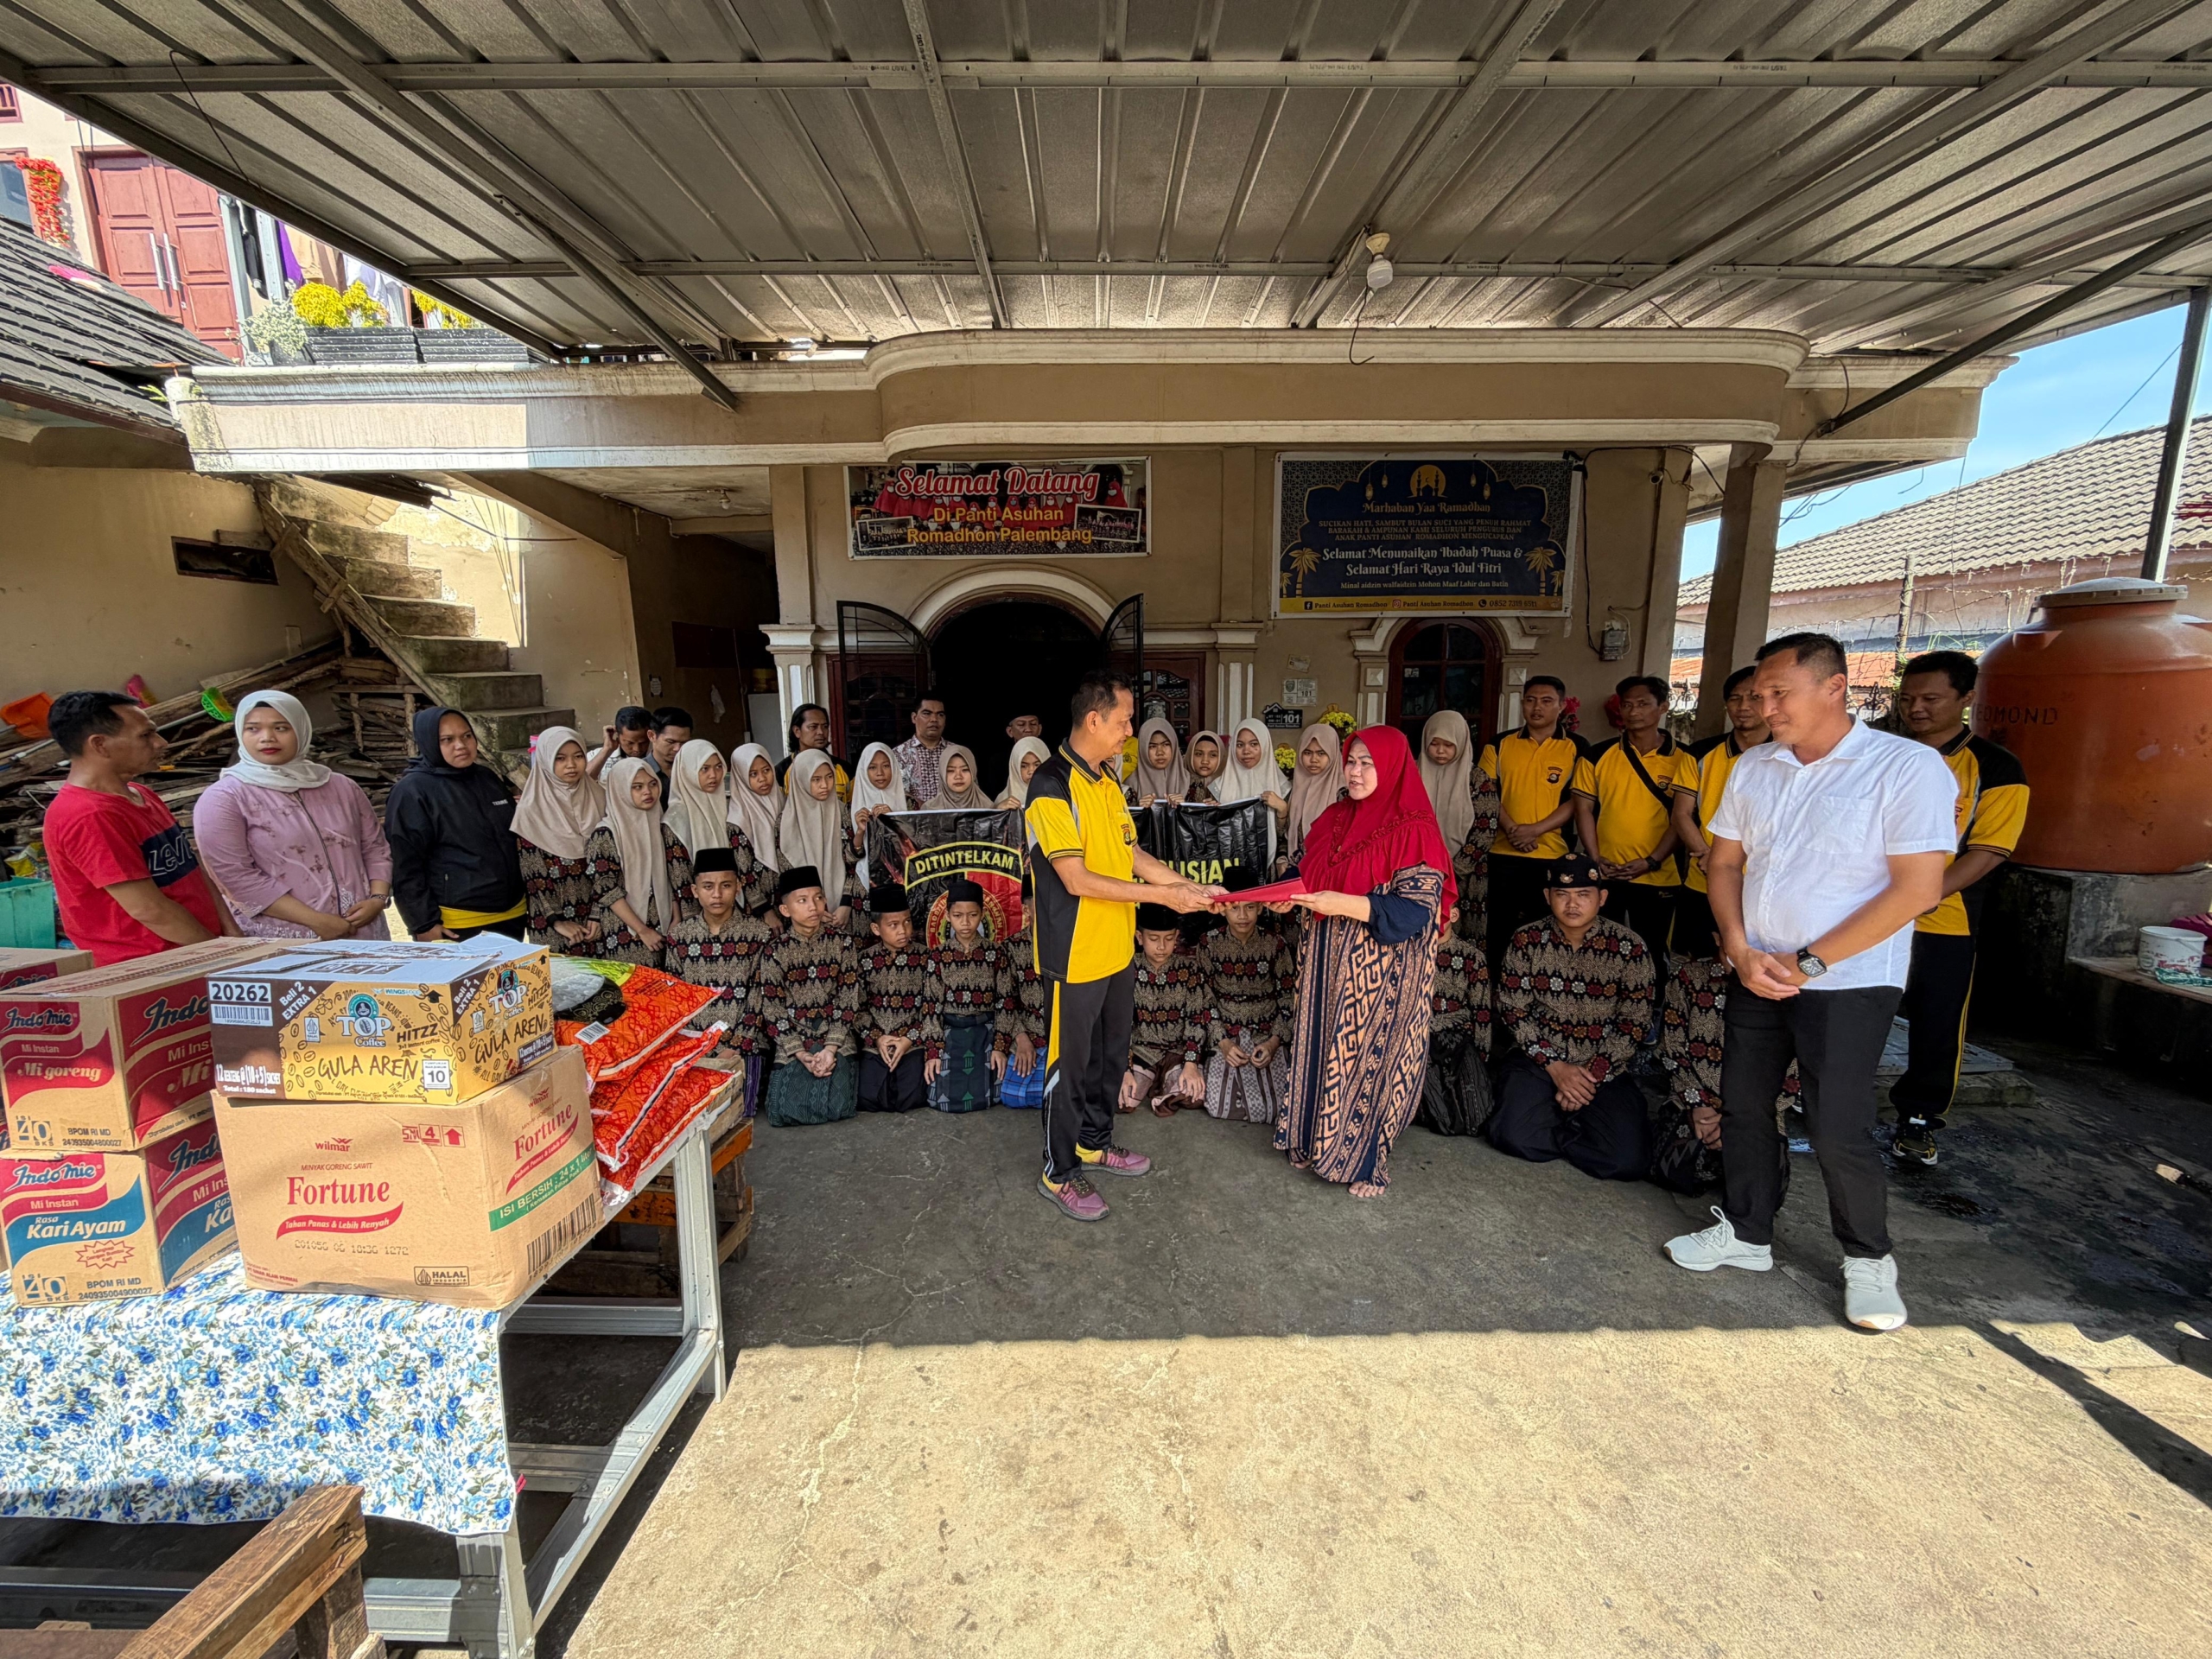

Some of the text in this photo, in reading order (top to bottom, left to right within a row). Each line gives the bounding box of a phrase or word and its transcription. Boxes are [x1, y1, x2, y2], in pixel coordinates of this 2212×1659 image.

[895, 466, 1101, 500] Selamat Datang
[934, 505, 1064, 523] Di Panti Asuhan
[1362, 500, 1491, 516] Marhaban Yaa Ramadhan
[907, 527, 1093, 544] Romadhon Palembang
[1322, 545, 1523, 561] Selamat Menunaikan Ibadah Puasa &
[1345, 561, 1502, 576] Selamat Hari Raya Idul Fitri
[1283, 714, 1300, 723] 101
[915, 850, 1014, 875] DITINTELKAM
[211, 982, 270, 1002] 20262
[279, 982, 305, 1007] Beli 2
[454, 978, 472, 1004] Beli 2
[488, 985, 528, 1015] TOP
[282, 986, 317, 1021] EXTRA 1
[455, 988, 477, 1015] EXTRA
[132, 996, 209, 1045] Indo
[503, 1005, 525, 1020] Coffee
[336, 1015, 393, 1038] TOP
[397, 1023, 438, 1043] HITZZ
[22, 1044, 60, 1053] Mi Instan
[353, 1035, 387, 1048] Coffee
[475, 1013, 544, 1065] GULA AREN
[168, 1039, 212, 1062] Mi Ins
[44, 1065, 102, 1082] goreng
[167, 1058, 213, 1093] Mi
[318, 1054, 419, 1080] GULA AREN
[428, 1070, 446, 1084] 10
[528, 1092, 550, 1109] wilmar
[17, 1120, 54, 1141] 40
[67, 1128, 90, 1136] BPOM
[425, 1126, 435, 1139] 4
[512, 1103, 572, 1162] Fortune
[315, 1141, 351, 1153] wilmar
[193, 1176, 229, 1202] Mi Ins
[286, 1176, 391, 1205] Fortune
[499, 1204, 515, 1219] ISI
[517, 1178, 554, 1210] BERSIH
[559, 1166, 569, 1180] 24
[30, 1198, 79, 1209] Mi Instan
[213, 1196, 232, 1211] Ras
[26, 1217, 126, 1239] Kari Ayam
[35, 1215, 59, 1224] Rasa
[205, 1205, 234, 1233] Ka
[285, 1217, 390, 1230] Tahan Panas & Lebih Renyah
[86, 1277, 141, 1289] BPOM RI MD
[432, 1270, 467, 1279] HALAL
[23, 1277, 67, 1300] 40
[78, 1287, 153, 1300] 240935004900027
